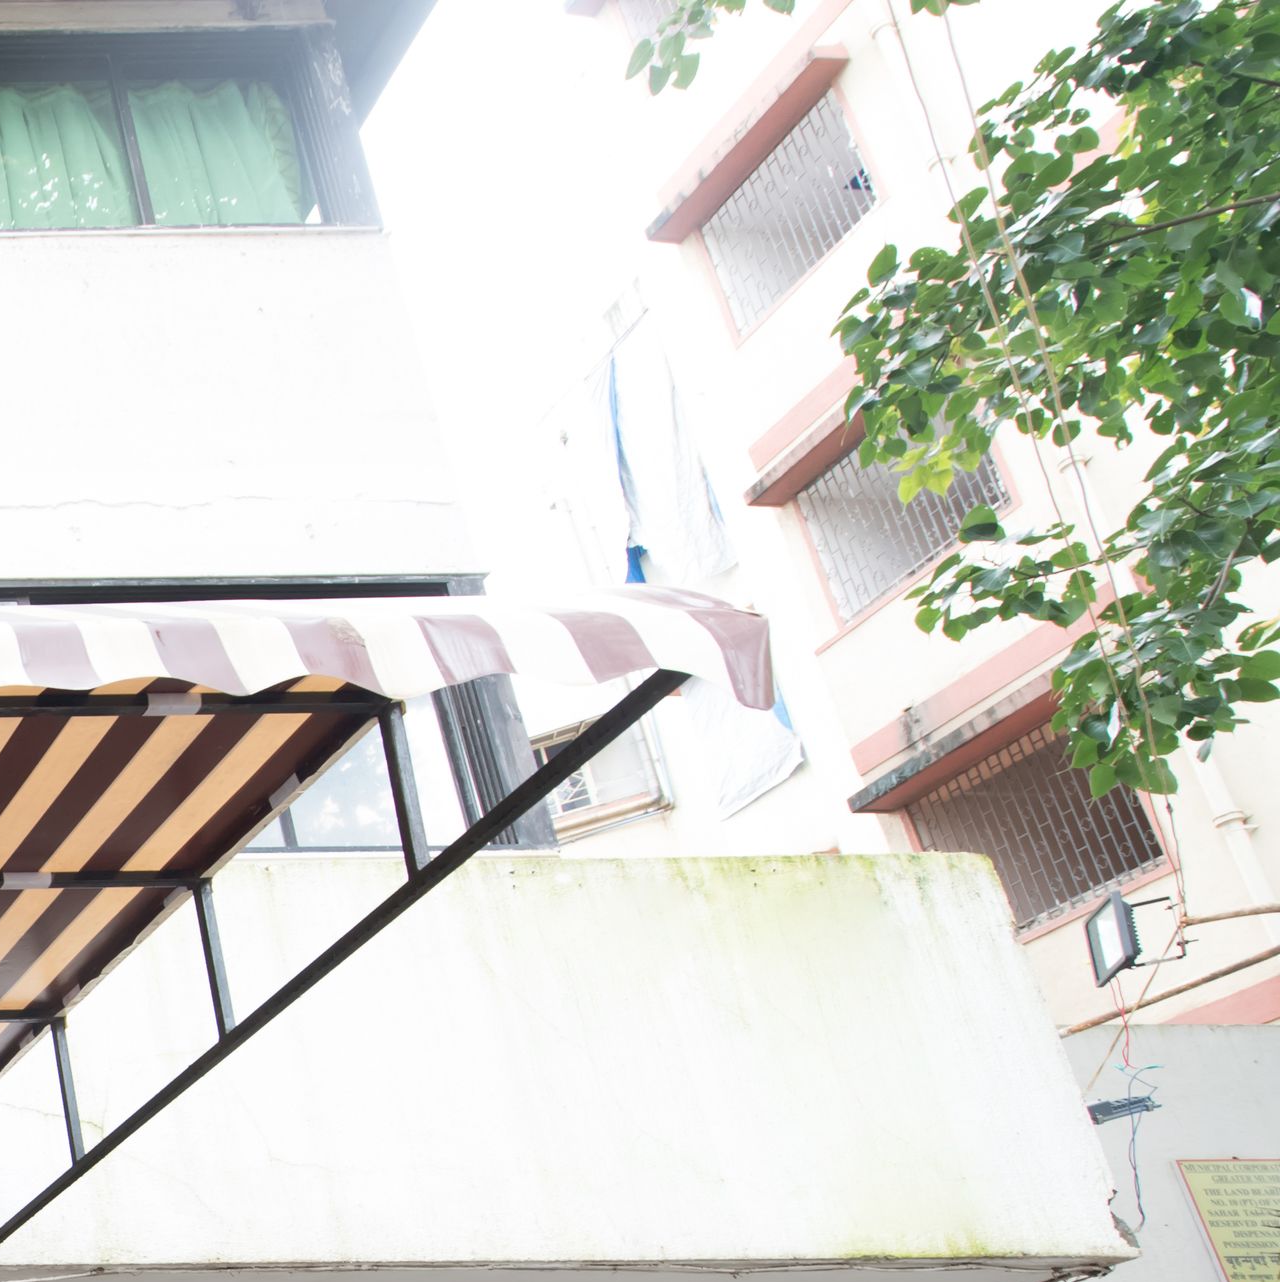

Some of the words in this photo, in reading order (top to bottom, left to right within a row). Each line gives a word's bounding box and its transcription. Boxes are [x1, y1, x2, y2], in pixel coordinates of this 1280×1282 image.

[1183, 1164, 1232, 1173] MUNICIPAL
[1211, 1175, 1251, 1184] GREATER
[1203, 1188, 1221, 1196] THE
[1223, 1188, 1250, 1196] LAND
[1208, 1209, 1239, 1217] SAHAR
[1208, 1220, 1258, 1228] RESERVED
[1222, 1241, 1280, 1249] POSSESSION
